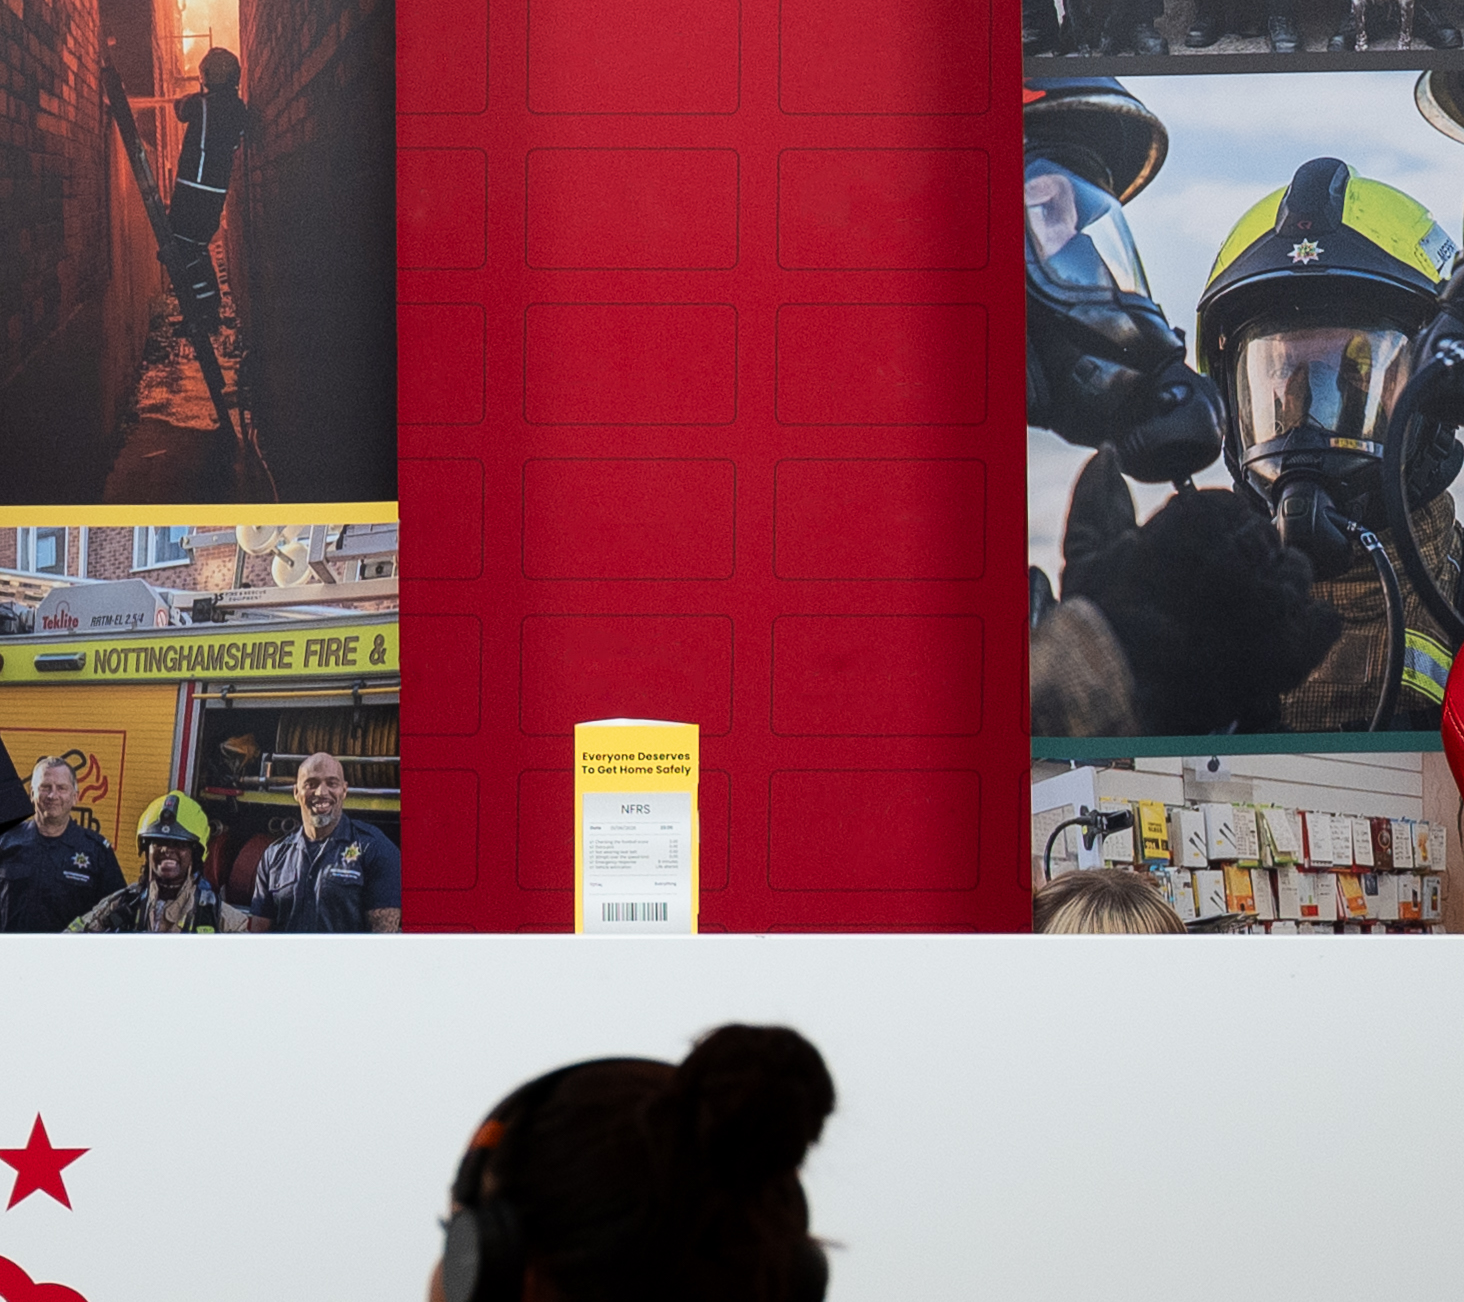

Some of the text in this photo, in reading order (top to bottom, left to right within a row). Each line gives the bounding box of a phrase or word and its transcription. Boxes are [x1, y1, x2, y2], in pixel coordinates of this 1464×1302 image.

[42, 608, 79, 630] Teklite
[94, 633, 387, 675] NOTTINGHAMSHIRE FIRE &
[582, 752, 690, 763] Everyone Deserves
[582, 764, 691, 776] To Get Home Safely
[621, 804, 651, 814] NFRS
